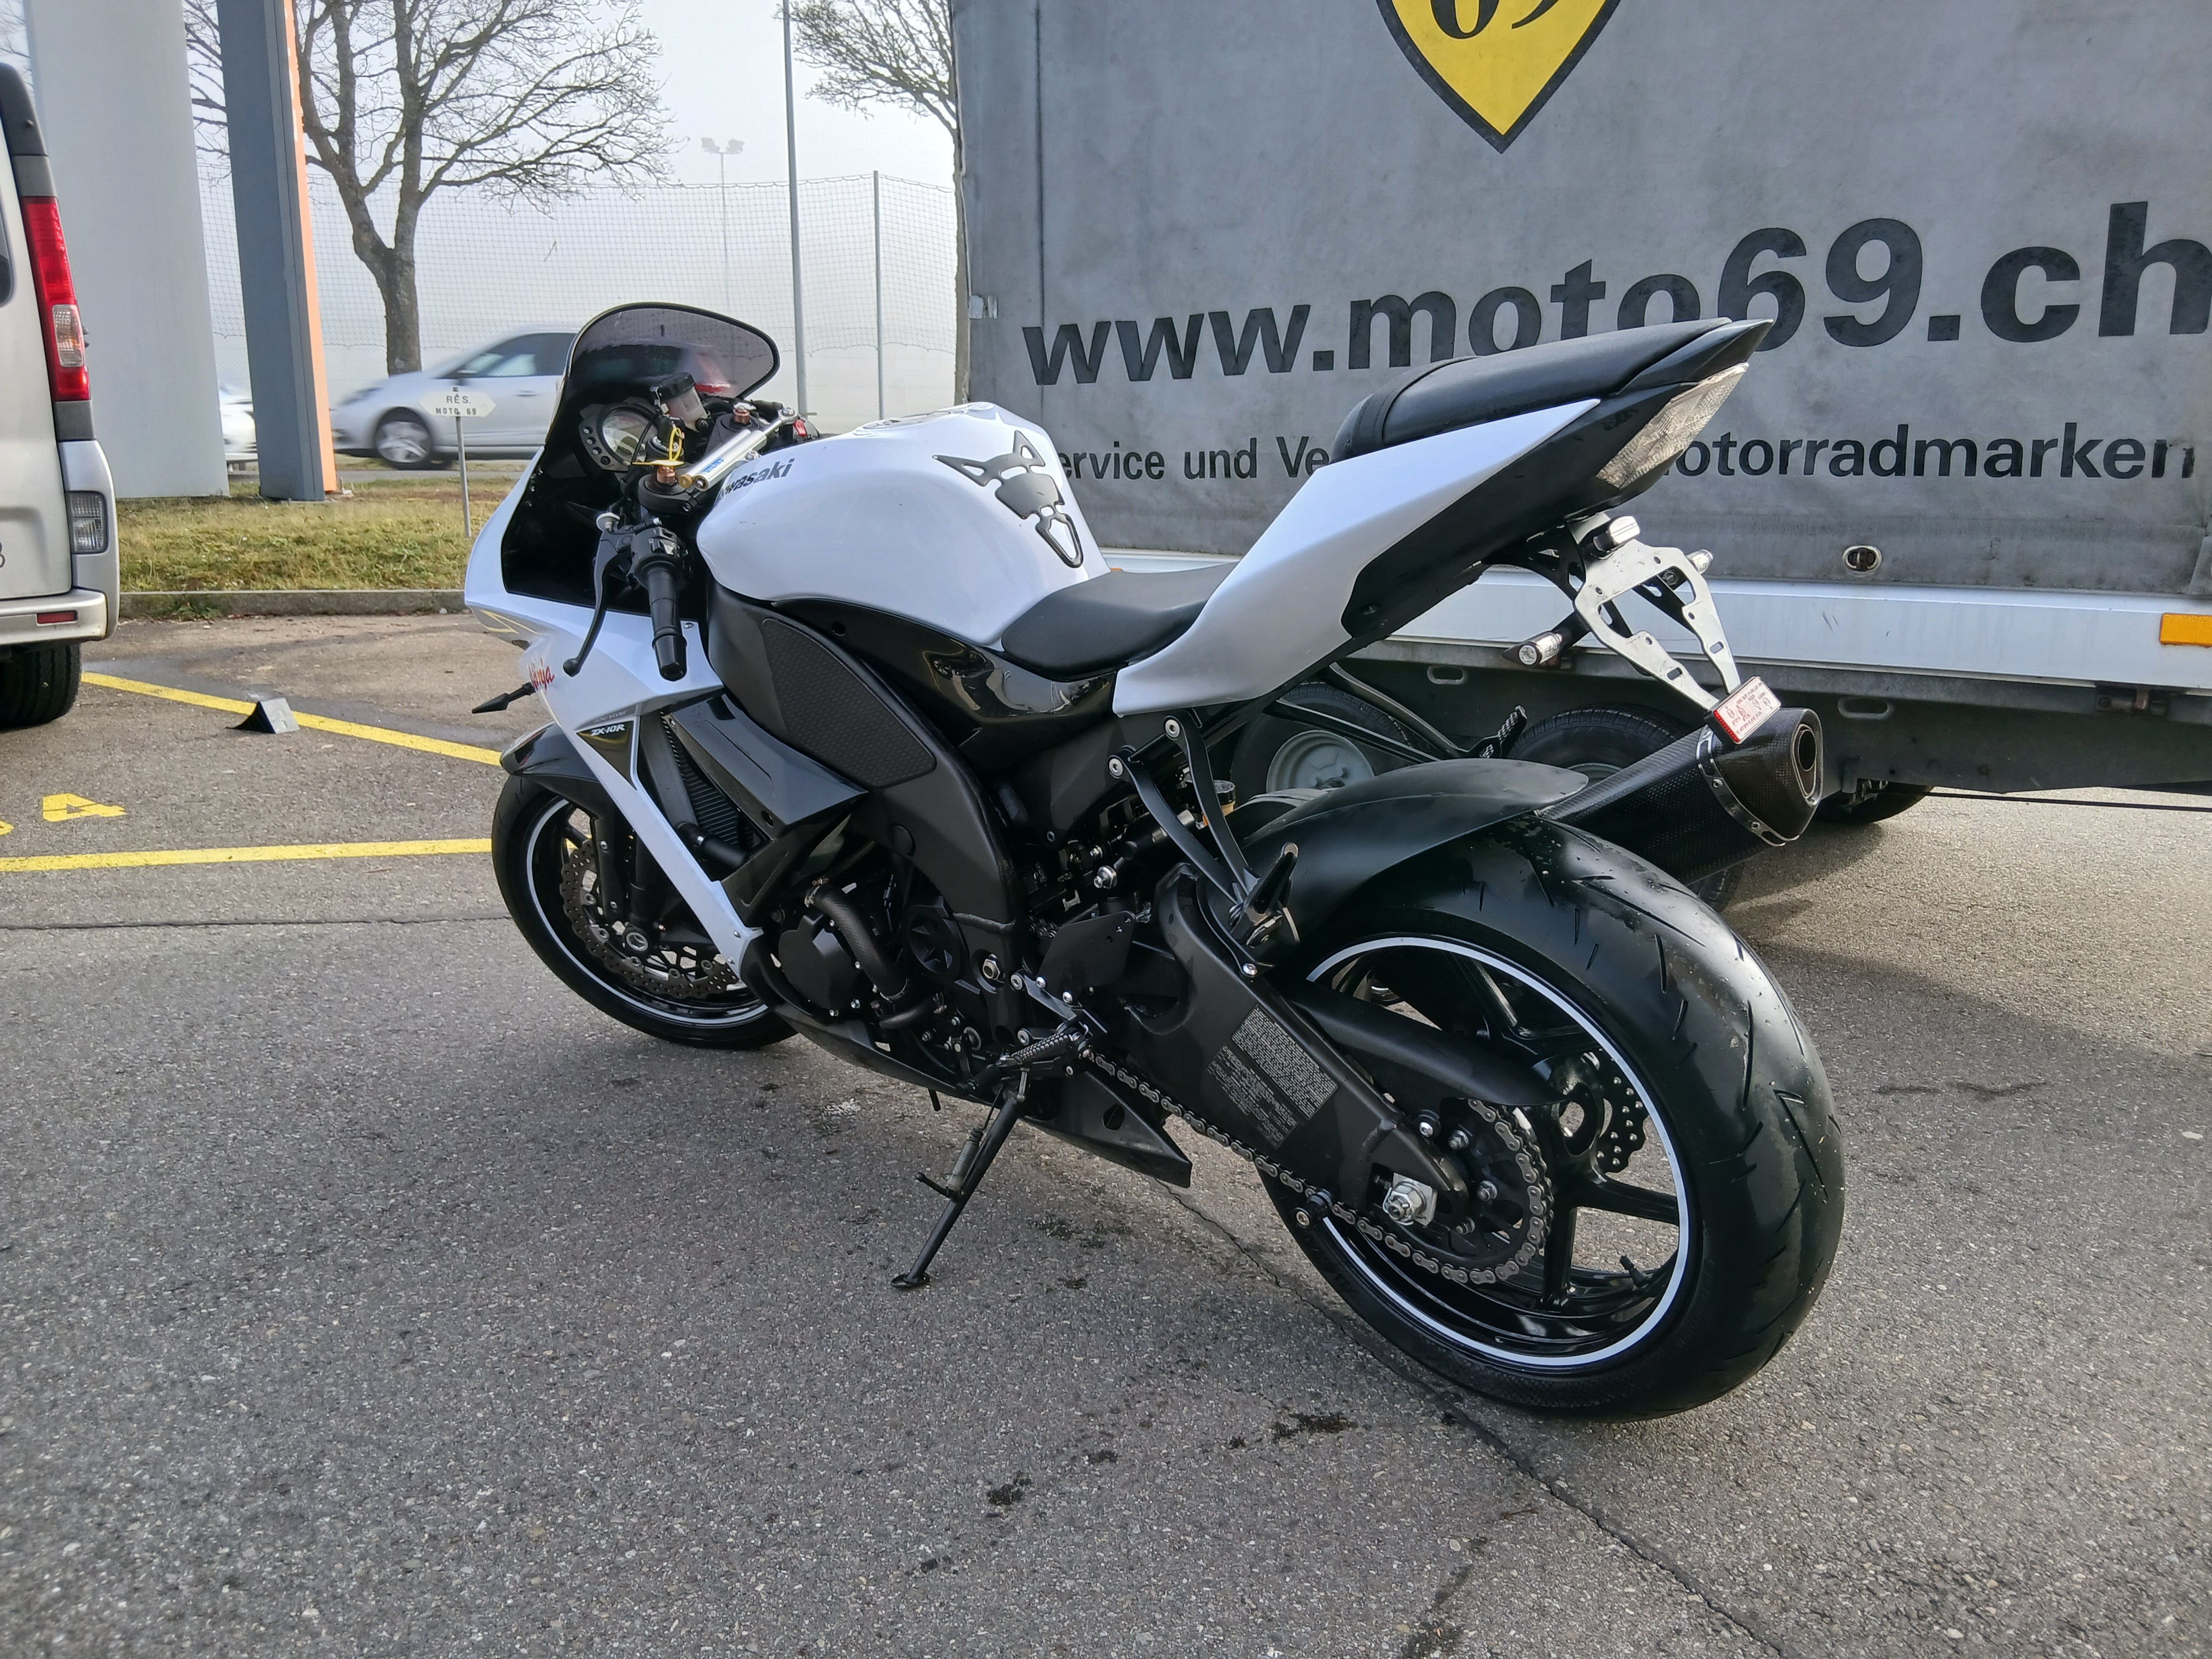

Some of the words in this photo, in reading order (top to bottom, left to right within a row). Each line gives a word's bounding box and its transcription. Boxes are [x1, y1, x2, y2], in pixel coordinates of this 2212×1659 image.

[1021, 201, 2212, 385] www.moto69.ch
[435, 407, 460, 415] MOTO
[1058, 441, 1165, 479] ervice
[1184, 436, 1257, 479] und
[1664, 422, 2195, 480] otorradmarken
